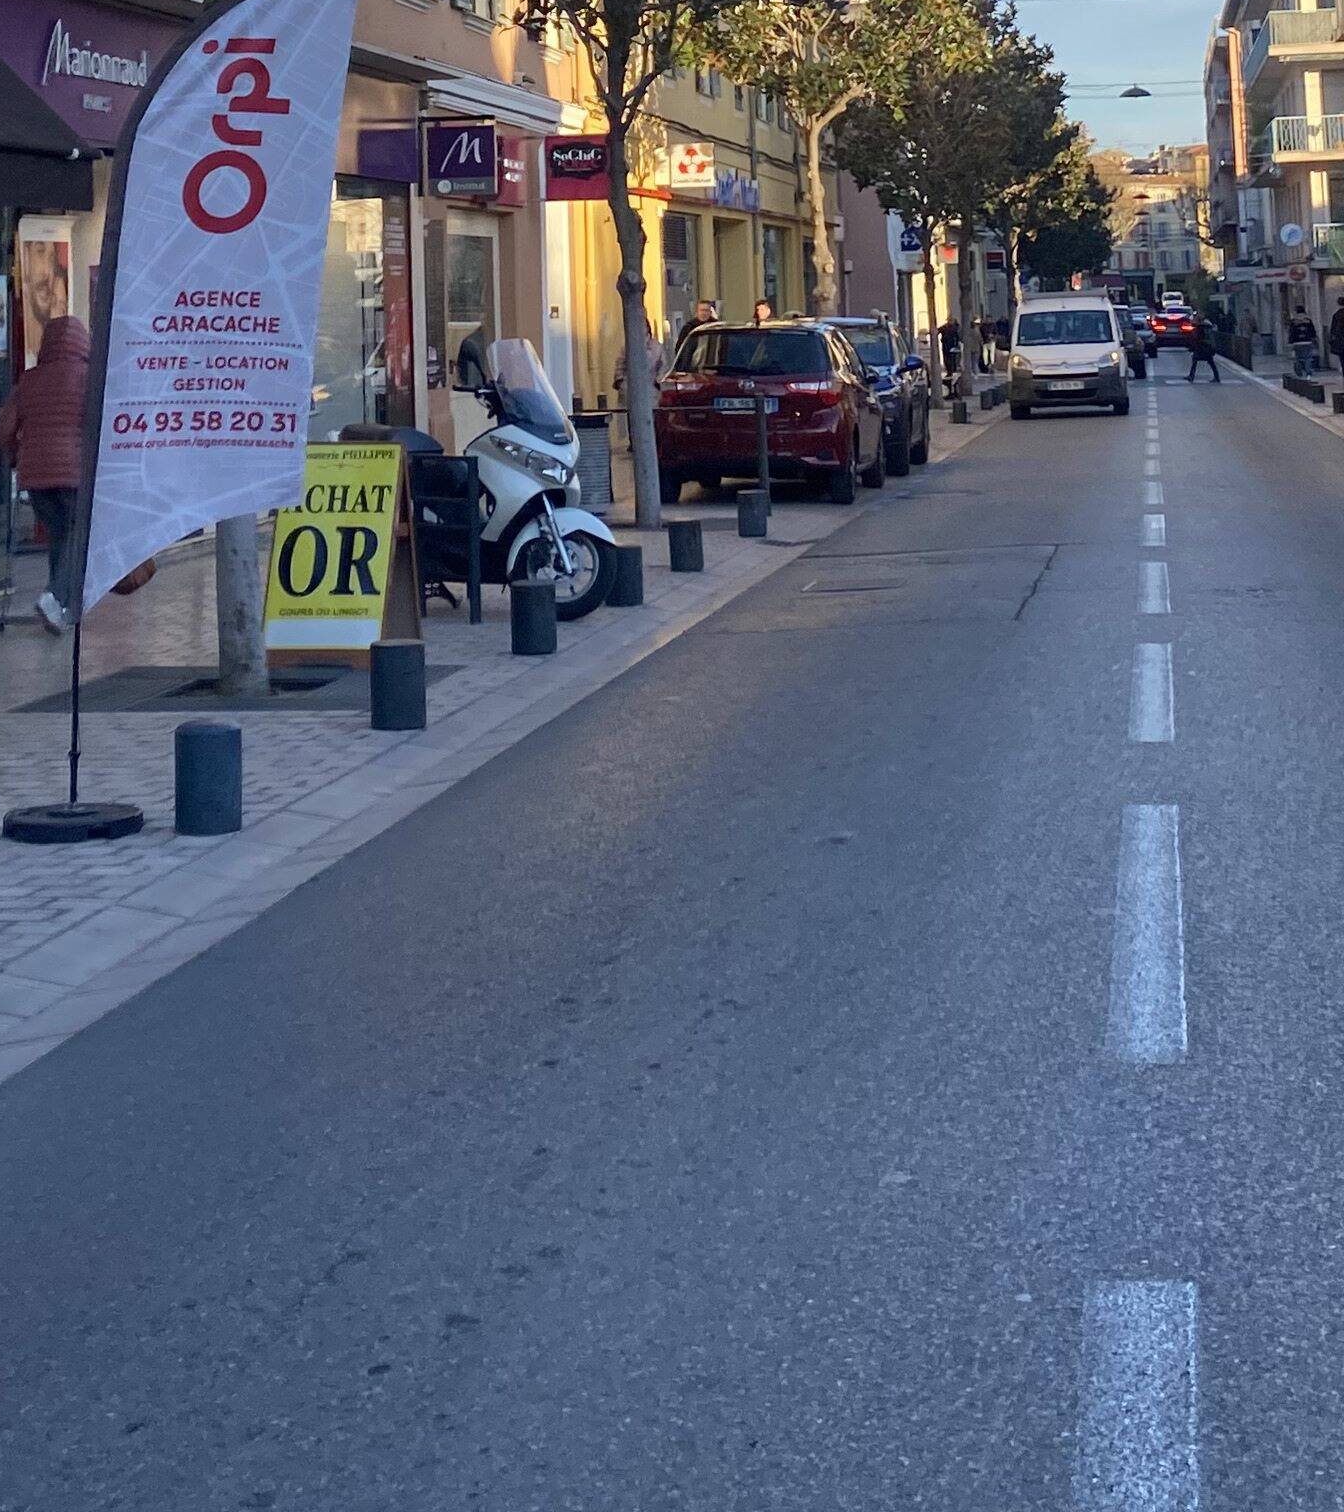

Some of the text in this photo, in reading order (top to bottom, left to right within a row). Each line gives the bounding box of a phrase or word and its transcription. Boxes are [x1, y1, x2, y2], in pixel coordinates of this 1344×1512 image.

[41, 18, 150, 88] Marionnaud
[182, 37, 291, 235] Orpi
[174, 290, 262, 309] AGENCE
[151, 315, 281, 334] CARACACHE
[136, 356, 188, 370] VENTE
[205, 356, 289, 371] LOCATION
[172, 377, 246, 392] GESTION
[112, 410, 298, 435] 04 93 58 20 31
[342, 449, 396, 461] PHILIPPE
[282, 484, 393, 515] CHAT
[277, 524, 382, 599] OR
